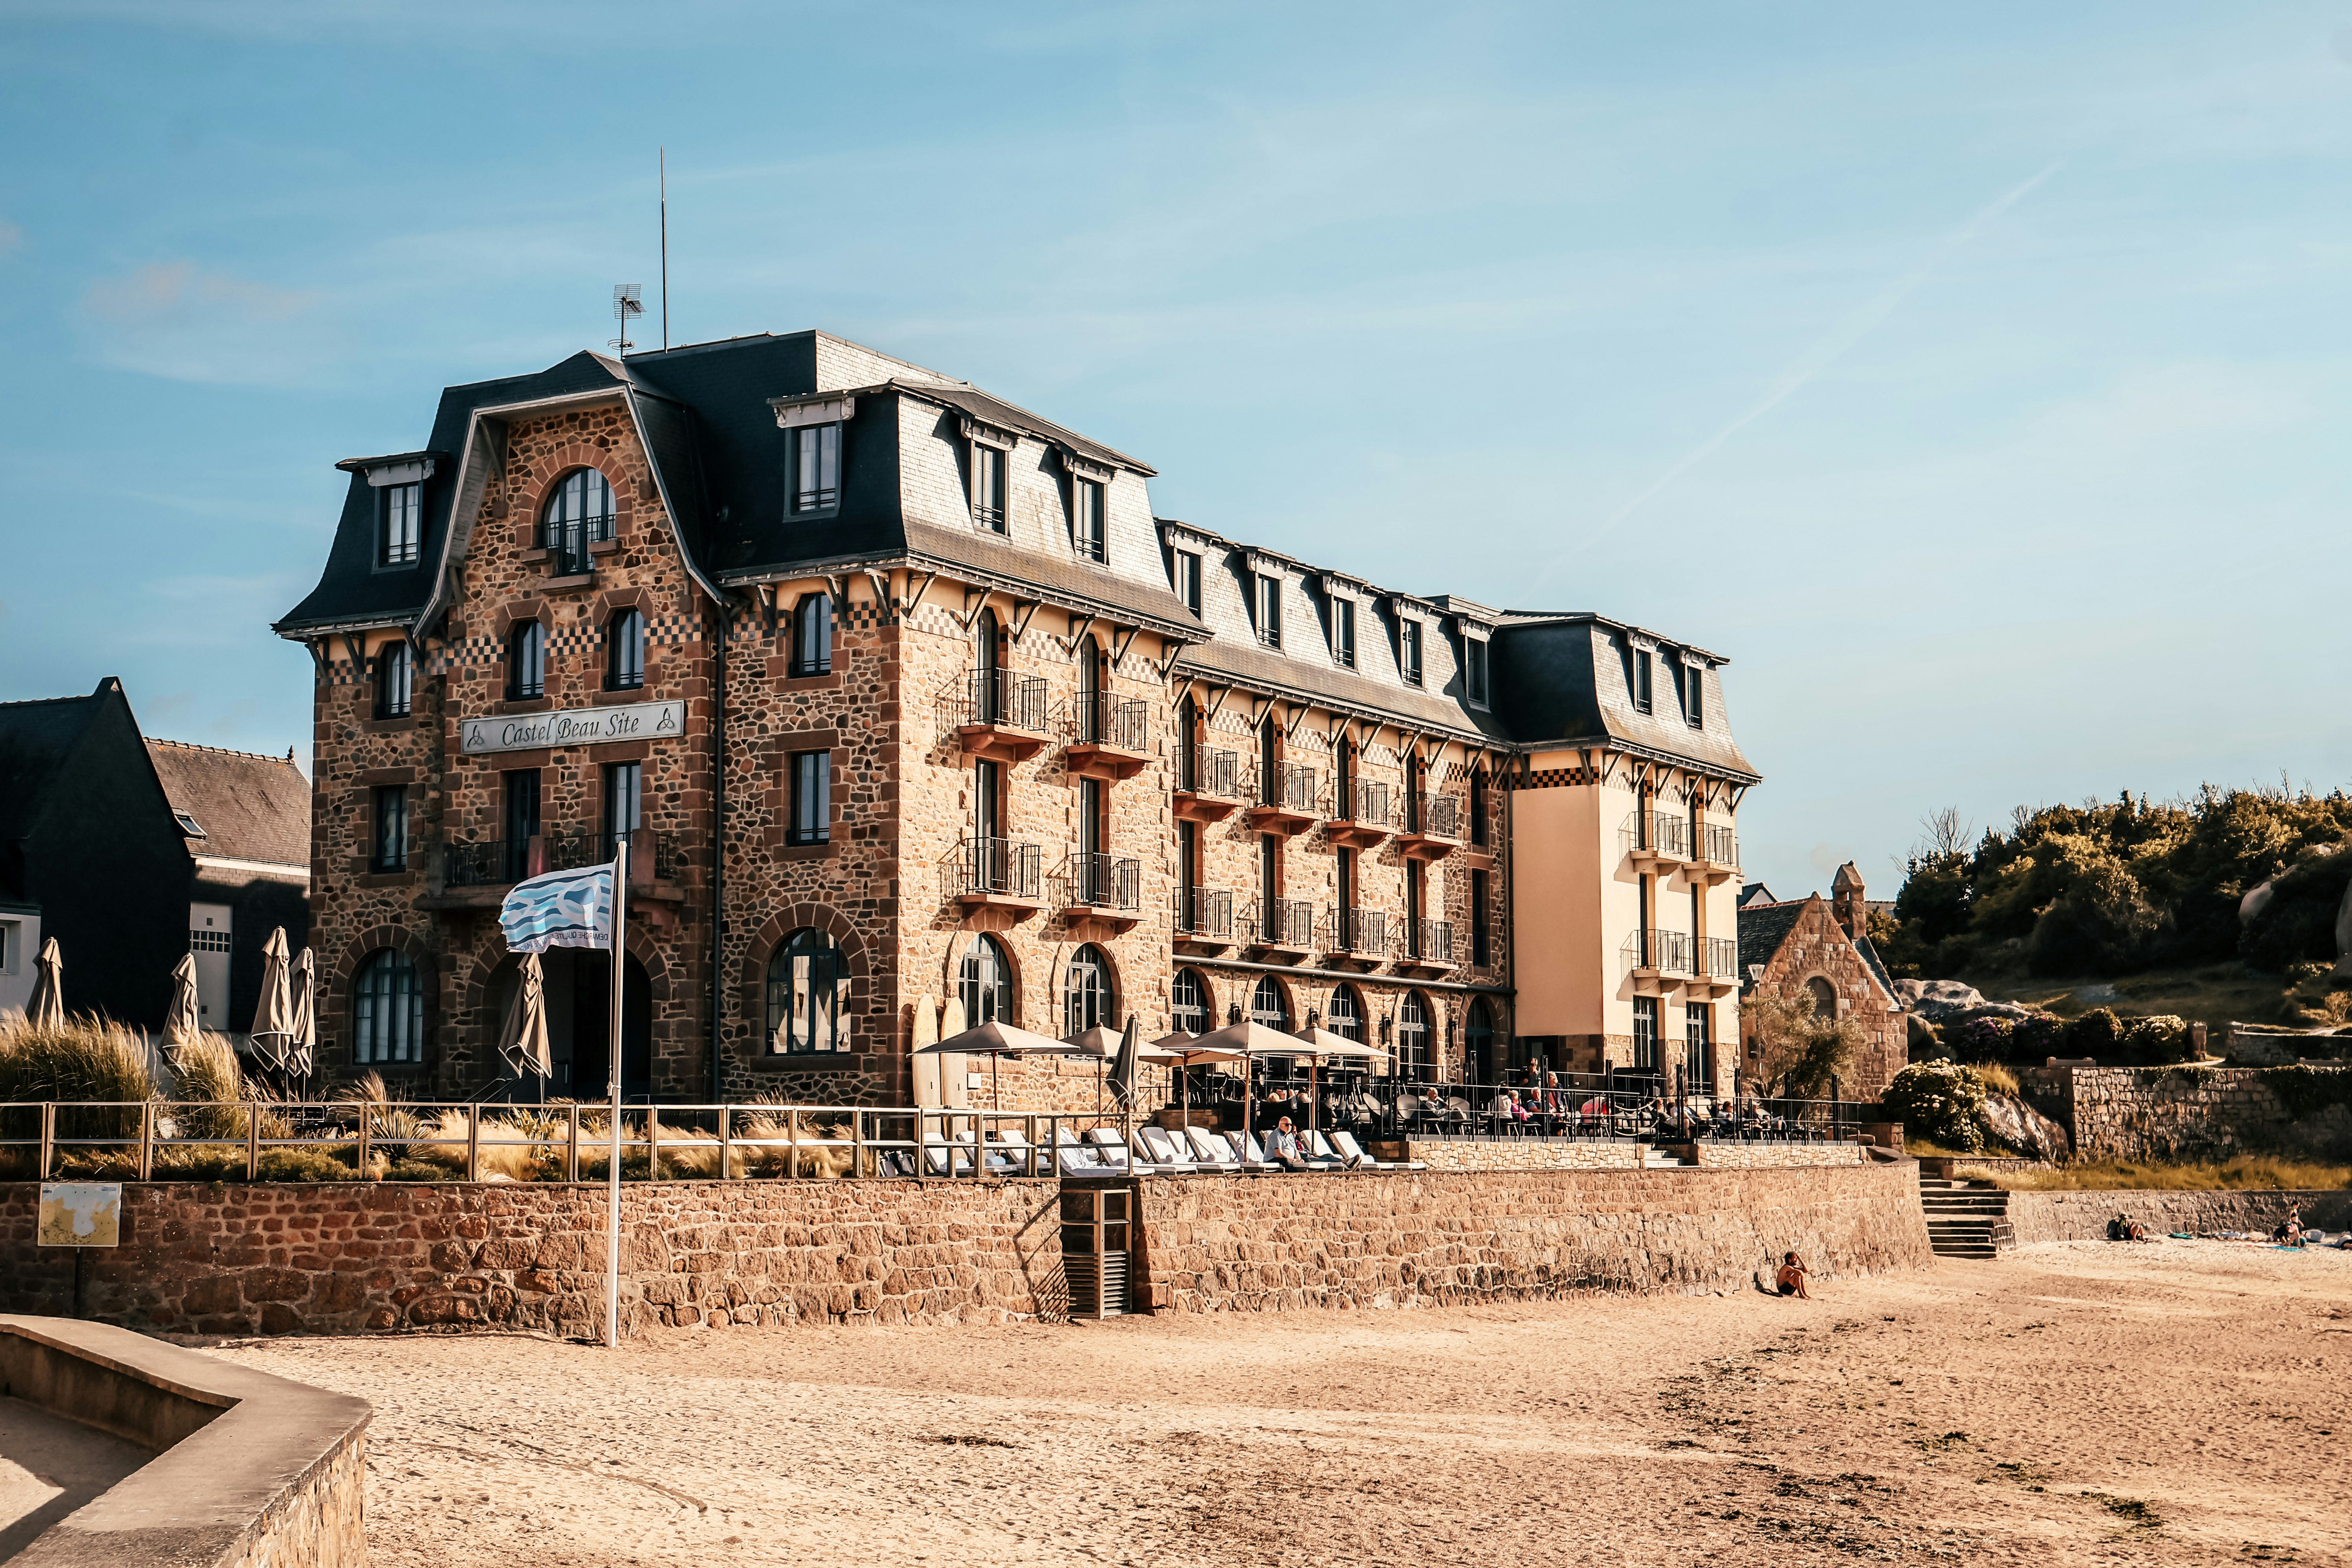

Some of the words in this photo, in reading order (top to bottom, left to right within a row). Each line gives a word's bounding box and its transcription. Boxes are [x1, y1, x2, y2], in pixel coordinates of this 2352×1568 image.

[502, 716, 555, 746] Castel
[558, 718, 599, 739] Beau
[605, 712, 639, 736] Site
